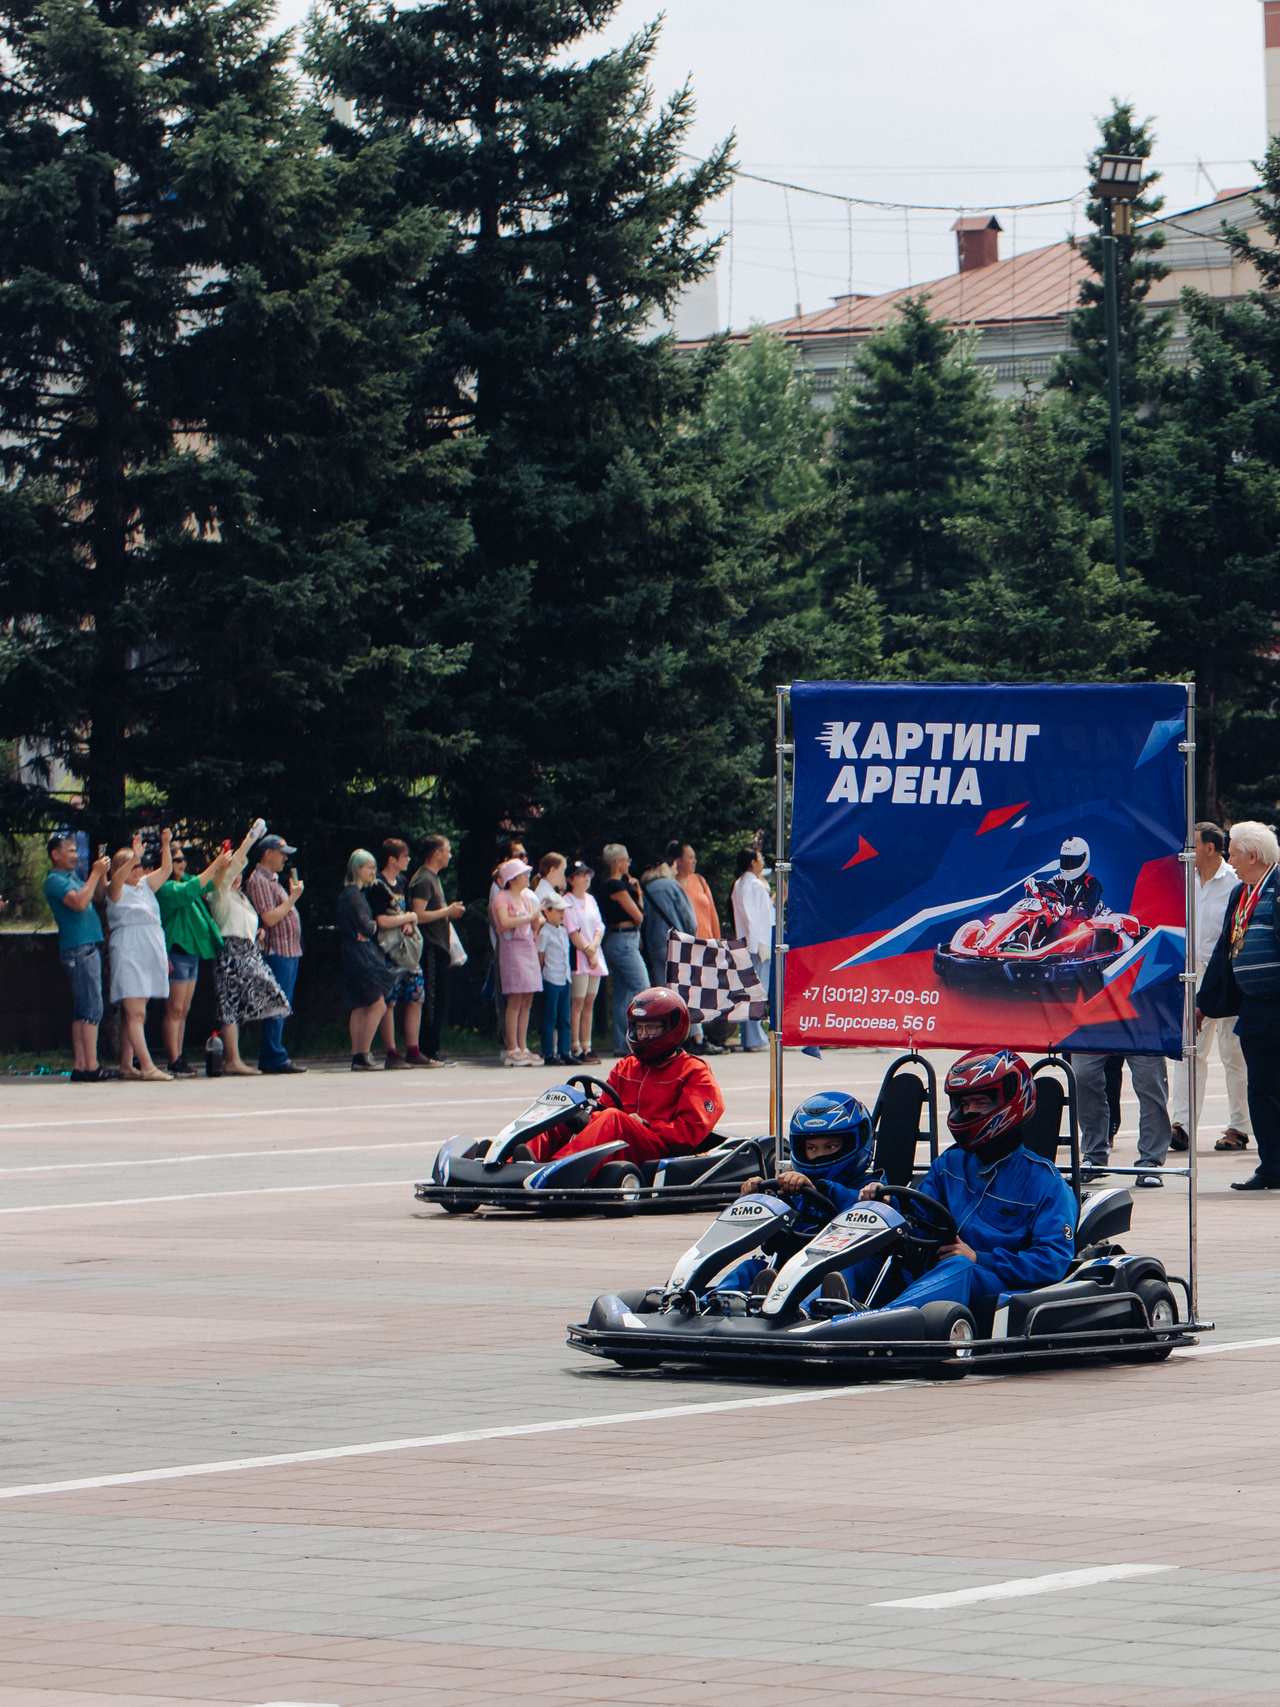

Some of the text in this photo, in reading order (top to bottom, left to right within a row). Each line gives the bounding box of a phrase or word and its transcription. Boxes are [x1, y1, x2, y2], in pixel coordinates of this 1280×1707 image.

[815, 722, 1040, 761] КАРТИНГ
[826, 765, 982, 805] АРЕНА
[802, 985, 940, 1005] +7 (3012) 37-09-60
[799, 1015, 821, 1032] ул.
[825, 1013, 899, 1032] Борсоева,
[902, 1015, 924, 1031] 56
[815, 1236, 851, 1249] 21
